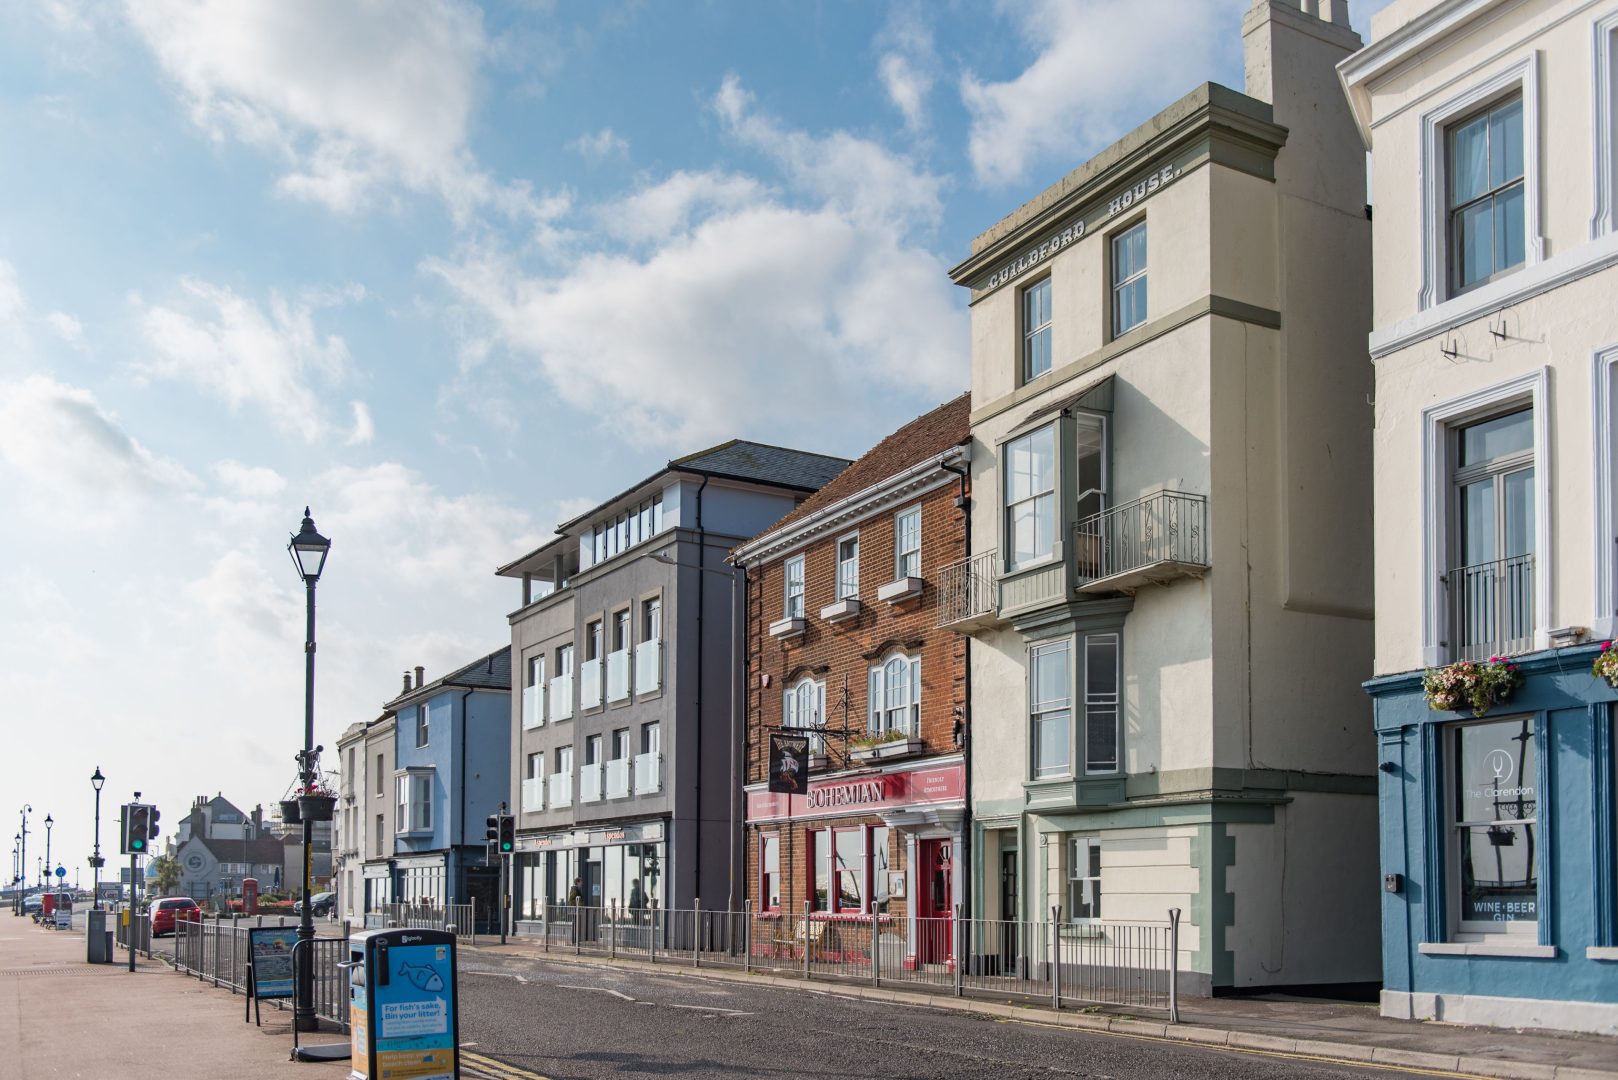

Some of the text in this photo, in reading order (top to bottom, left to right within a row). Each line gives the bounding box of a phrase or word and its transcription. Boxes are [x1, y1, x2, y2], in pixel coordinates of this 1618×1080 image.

[988, 220, 1086, 289] GUILDFORD
[807, 782, 886, 808] BOHEMIAN
[1465, 785, 1534, 798] The Clarendon
[1473, 902, 1535, 912] WINE BEER
[1493, 912, 1514, 921] GIN
